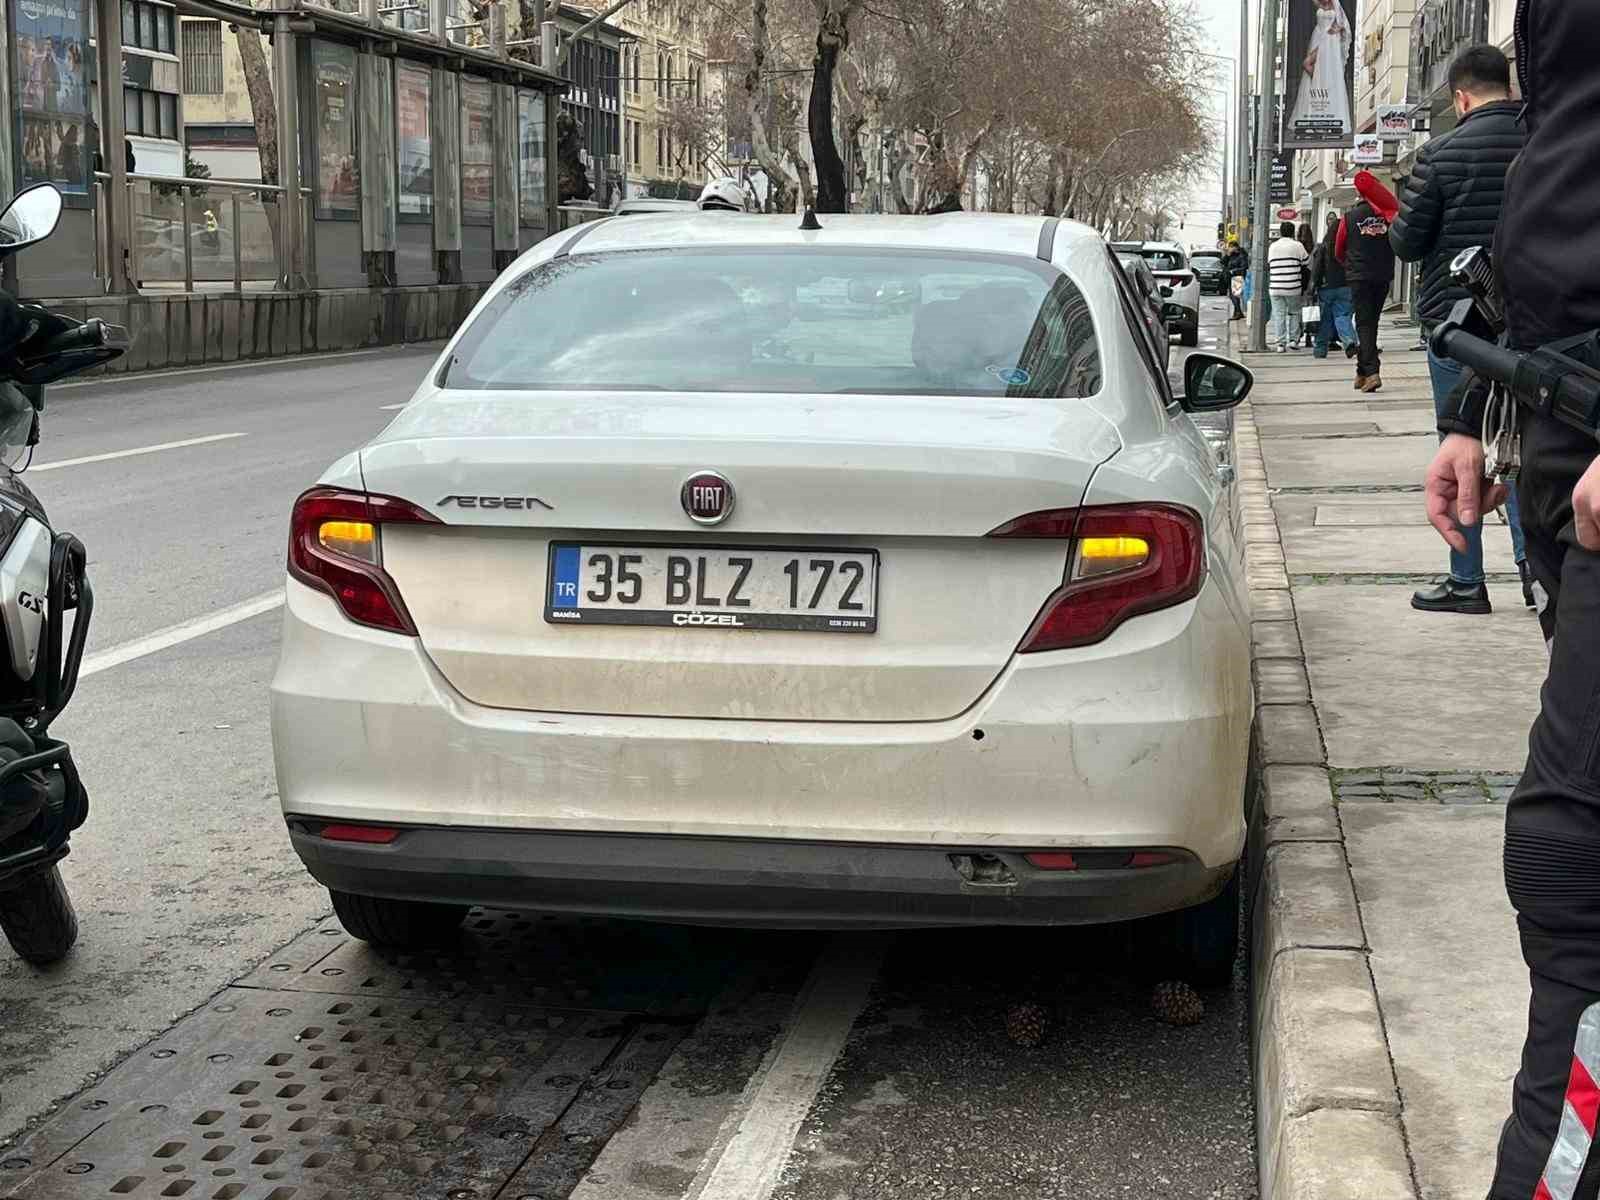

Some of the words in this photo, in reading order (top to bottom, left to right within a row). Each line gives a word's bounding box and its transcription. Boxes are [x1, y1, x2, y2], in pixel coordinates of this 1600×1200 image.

[692, 486, 723, 511] FIAT
[556, 582, 576, 597] TR
[587, 554, 643, 604] 35
[666, 556, 753, 606] BLZ
[784, 559, 864, 610] 172
[18, 591, 43, 614] GS
[672, 610, 745, 626] ÇÖZEL
